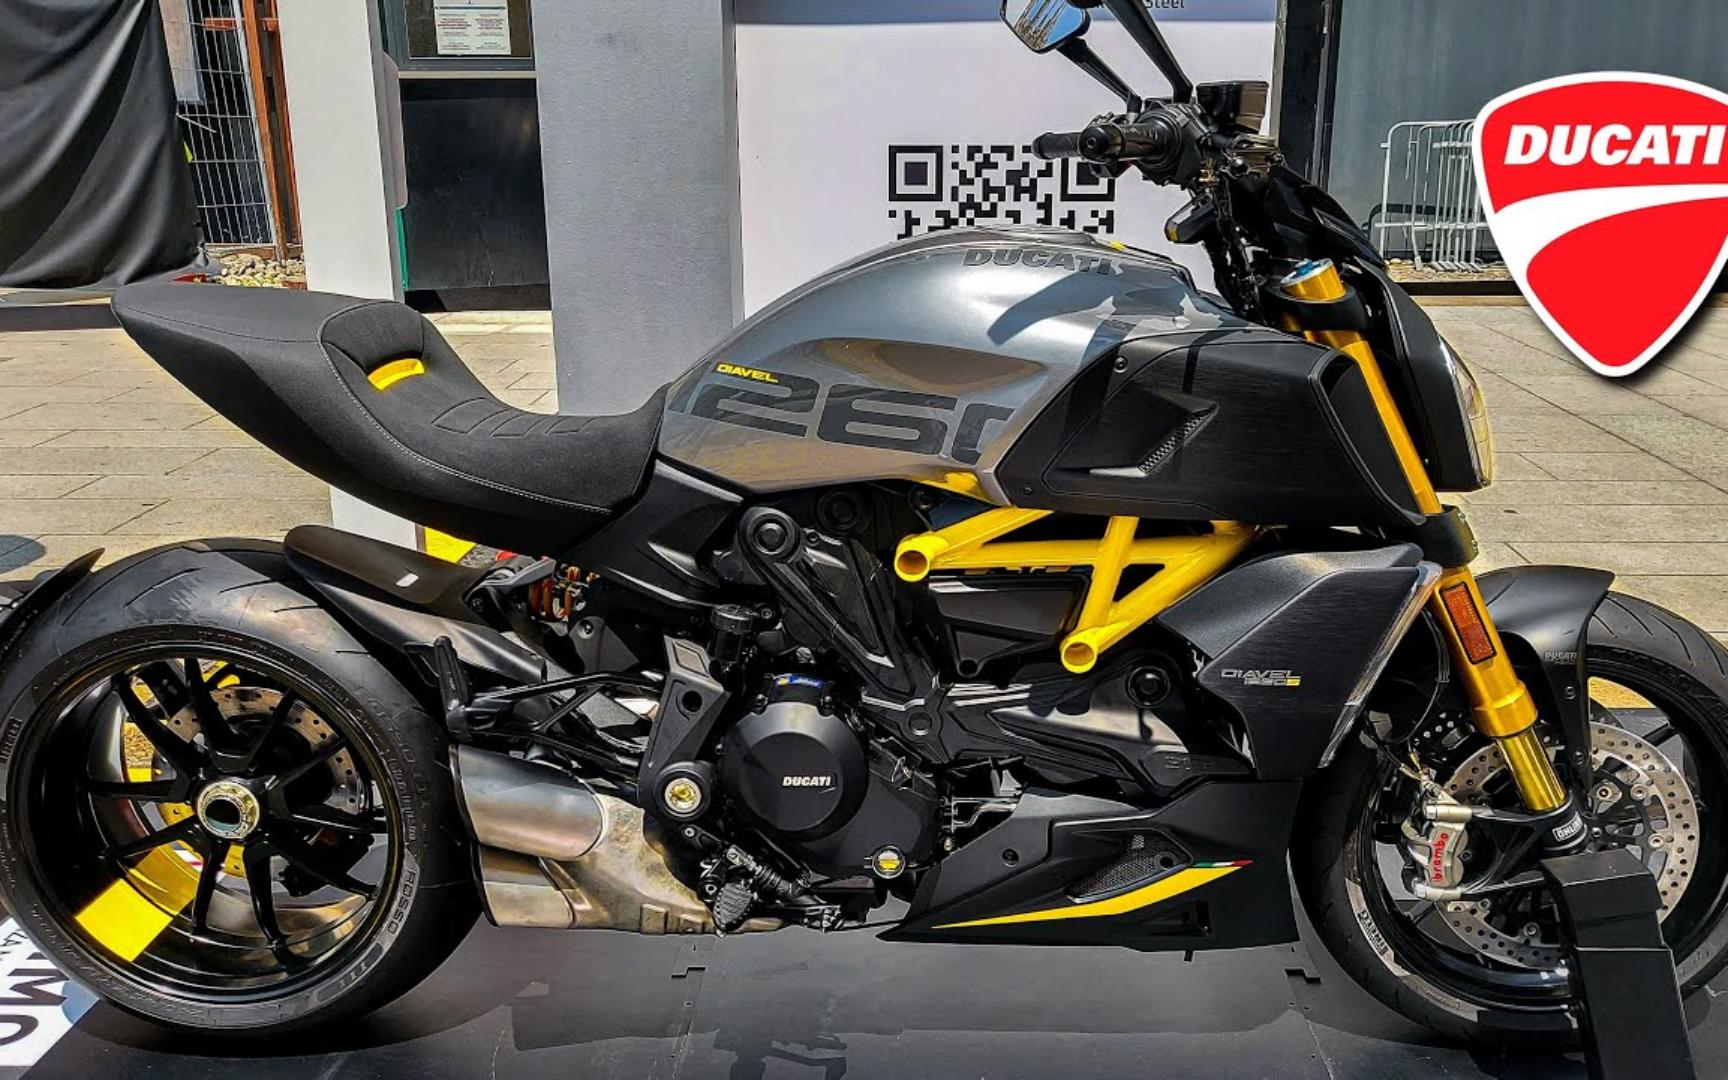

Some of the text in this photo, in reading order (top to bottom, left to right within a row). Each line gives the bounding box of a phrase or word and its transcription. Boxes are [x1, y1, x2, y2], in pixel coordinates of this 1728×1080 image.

[963, 249, 1113, 275] DUCATI
[715, 363, 779, 384] DIAVEL
[1221, 668, 1301, 679] DIAVEL
[782, 776, 832, 787] DUCATI
